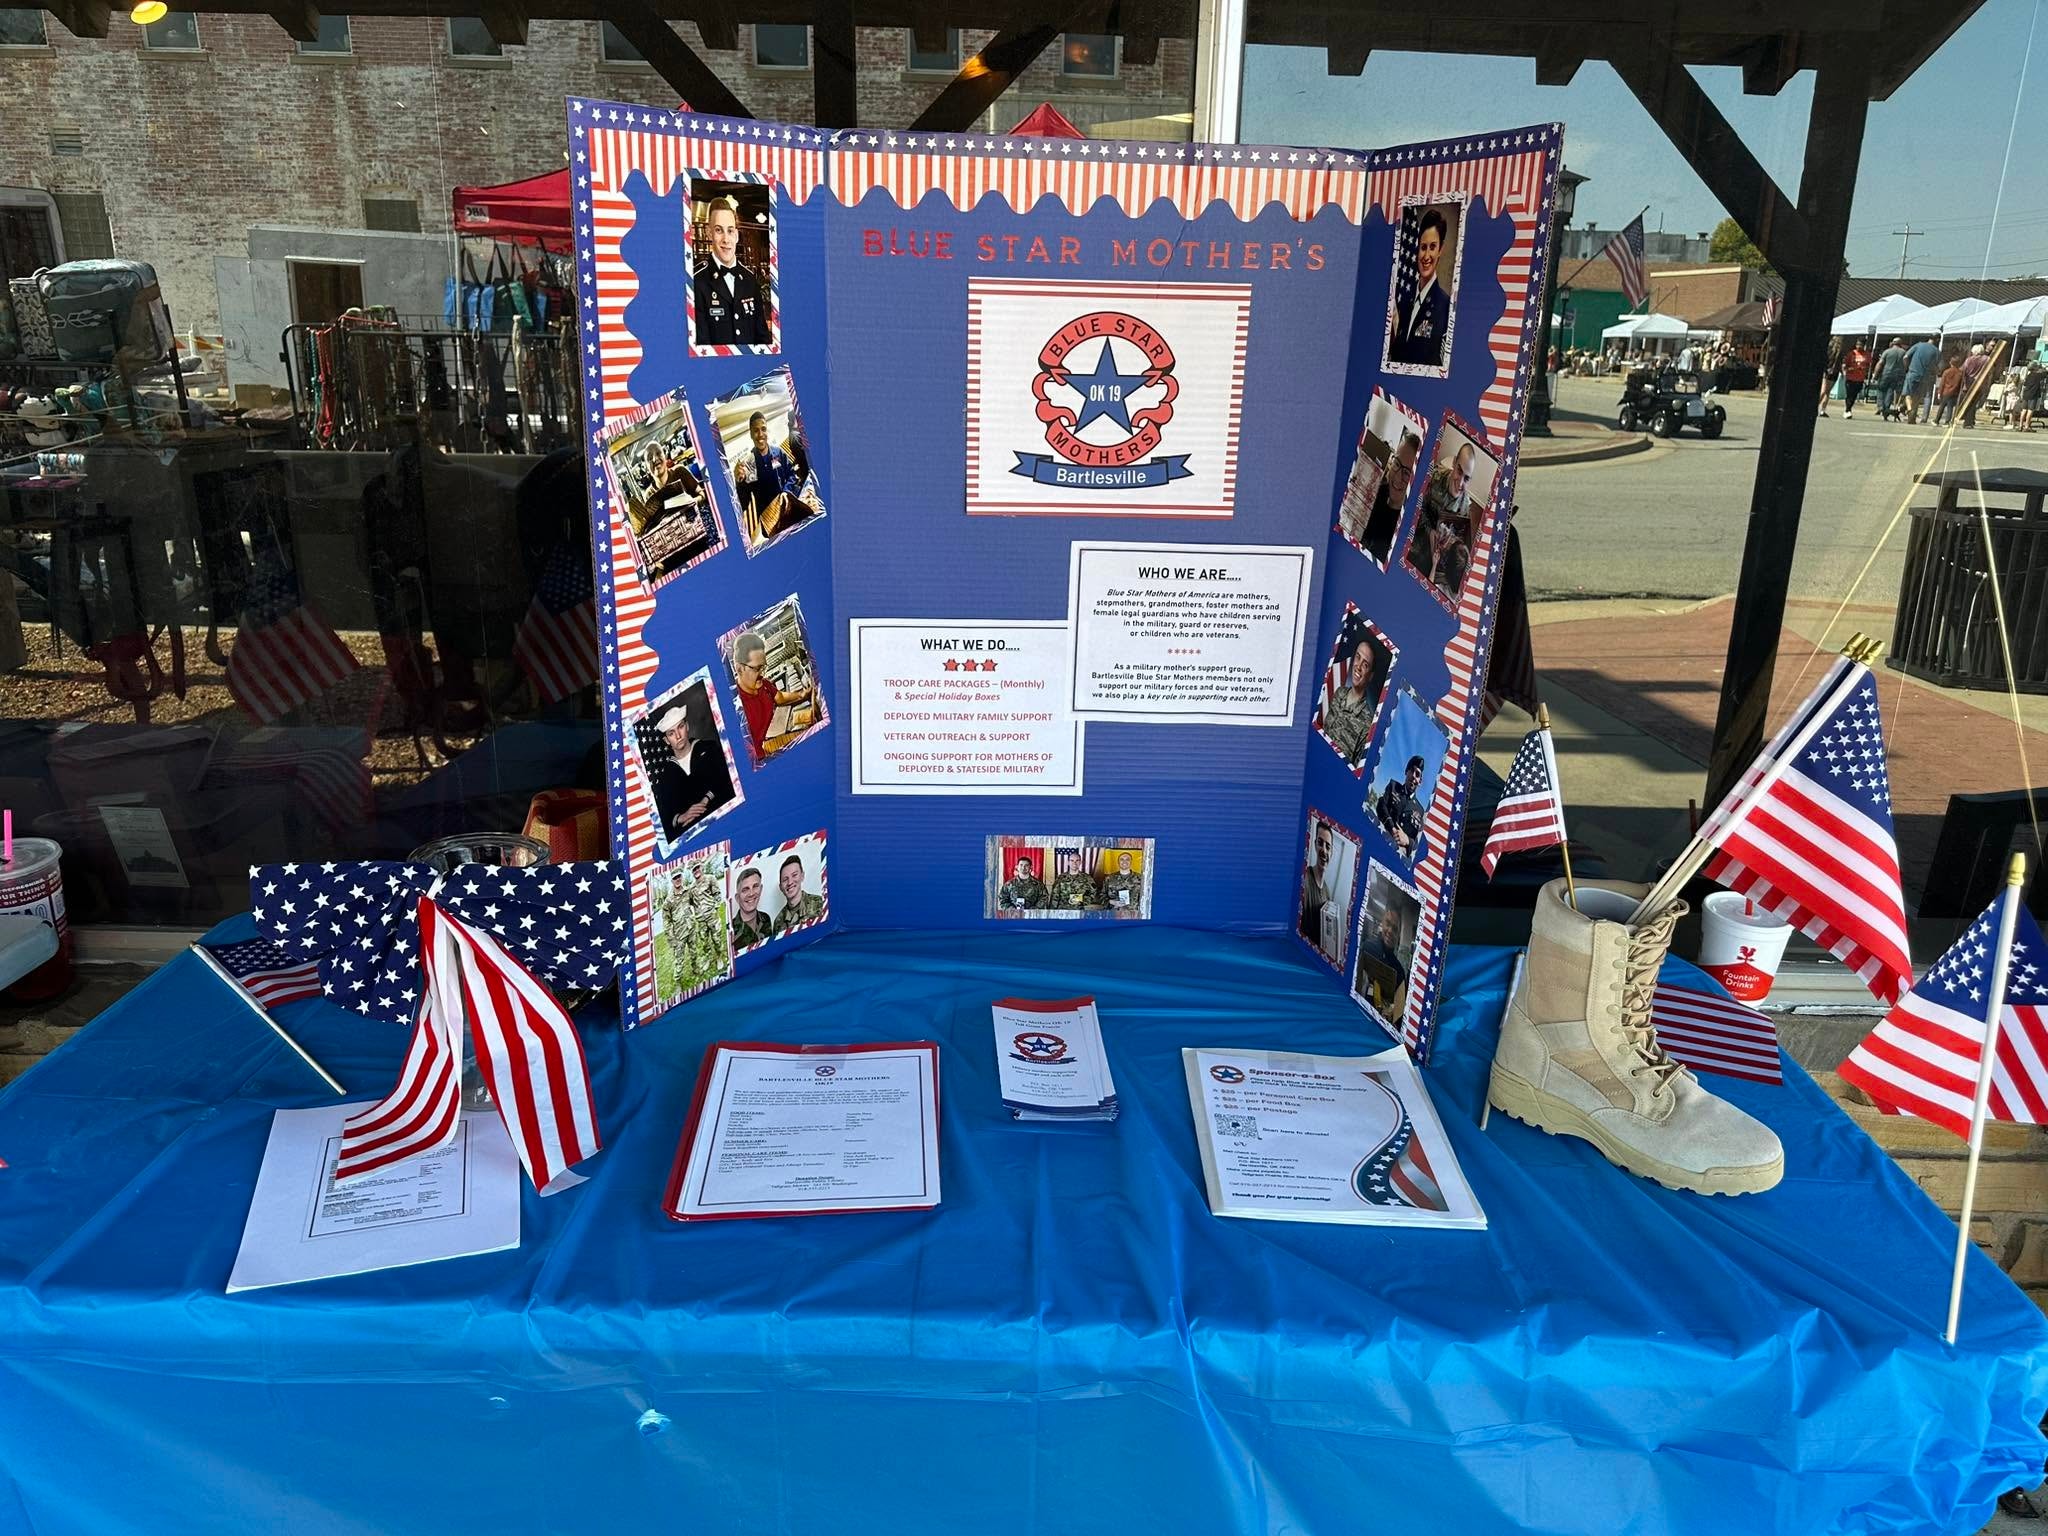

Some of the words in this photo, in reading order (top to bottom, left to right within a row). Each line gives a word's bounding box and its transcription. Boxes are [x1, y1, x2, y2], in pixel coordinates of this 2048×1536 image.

[862, 230, 954, 260] BLUE
[976, 234, 1082, 264] STAR
[1111, 238, 1327, 270] MOTHER'S
[1051, 318, 1100, 357] BLUE
[1114, 319, 1164, 358] STAR
[1090, 385, 1105, 401] OK
[1109, 386, 1121, 401] 19
[1053, 432, 1154, 463] MOTHERS
[1056, 468, 1146, 484] Bartlesville
[1139, 567, 1170, 578] WHO
[1175, 568, 1195, 579] WE
[1097, 600, 1146, 608] stepmothers,
[1121, 610, 1139, 618] legal
[1220, 612, 1250, 620] children
[1179, 621, 1201, 630] guard
[921, 639, 959, 650] WHAT
[963, 640, 983, 650] WE
[1133, 664, 1161, 672] military
[1198, 665, 1226, 673] support
[1092, 672, 1134, 680] Bartlesville
[884, 680, 916, 688] TROOP
[918, 680, 941, 688] CARE
[944, 680, 990, 688] PACKAGES
[1000, 680, 1045, 689] (Monthly)
[1144, 684, 1172, 692] military
[895, 692, 902, 700] &
[904, 692, 936, 701] Special
[938, 692, 972, 702] Holiday
[975, 693, 1000, 701] Boxes
[1123, 693, 1138, 701] play
[1147, 693, 1160, 702] key
[1188, 694, 1227, 702] supporting
[884, 713, 930, 721] DEPLOYED
[933, 713, 974, 721] MILITARY
[977, 713, 1009, 721] FAMILY
[1011, 713, 1052, 721] SUPPORT
[884, 733, 925, 741] VETERAN
[928, 733, 977, 741] OUTREACH
[979, 733, 986, 741] &
[989, 733, 1030, 741] SUPPORT
[884, 753, 929, 761] ONGOING
[931, 753, 973, 761] SUPPORT
[976, 753, 992, 761] FOR
[995, 753, 1038, 762] MOTHERS
[1041, 753, 1053, 762] OF
[898, 765, 944, 773] DEPLOYED
[957, 765, 1001, 774] STATESIDE
[1004, 766, 1044, 774] MILITARY
[18, 884, 45, 897] THING
[1723, 970, 1760, 982] Fountain
[1726, 978, 1753, 988] Drinks
[1249, 1068, 1336, 1081] Sponsor-a-Box
